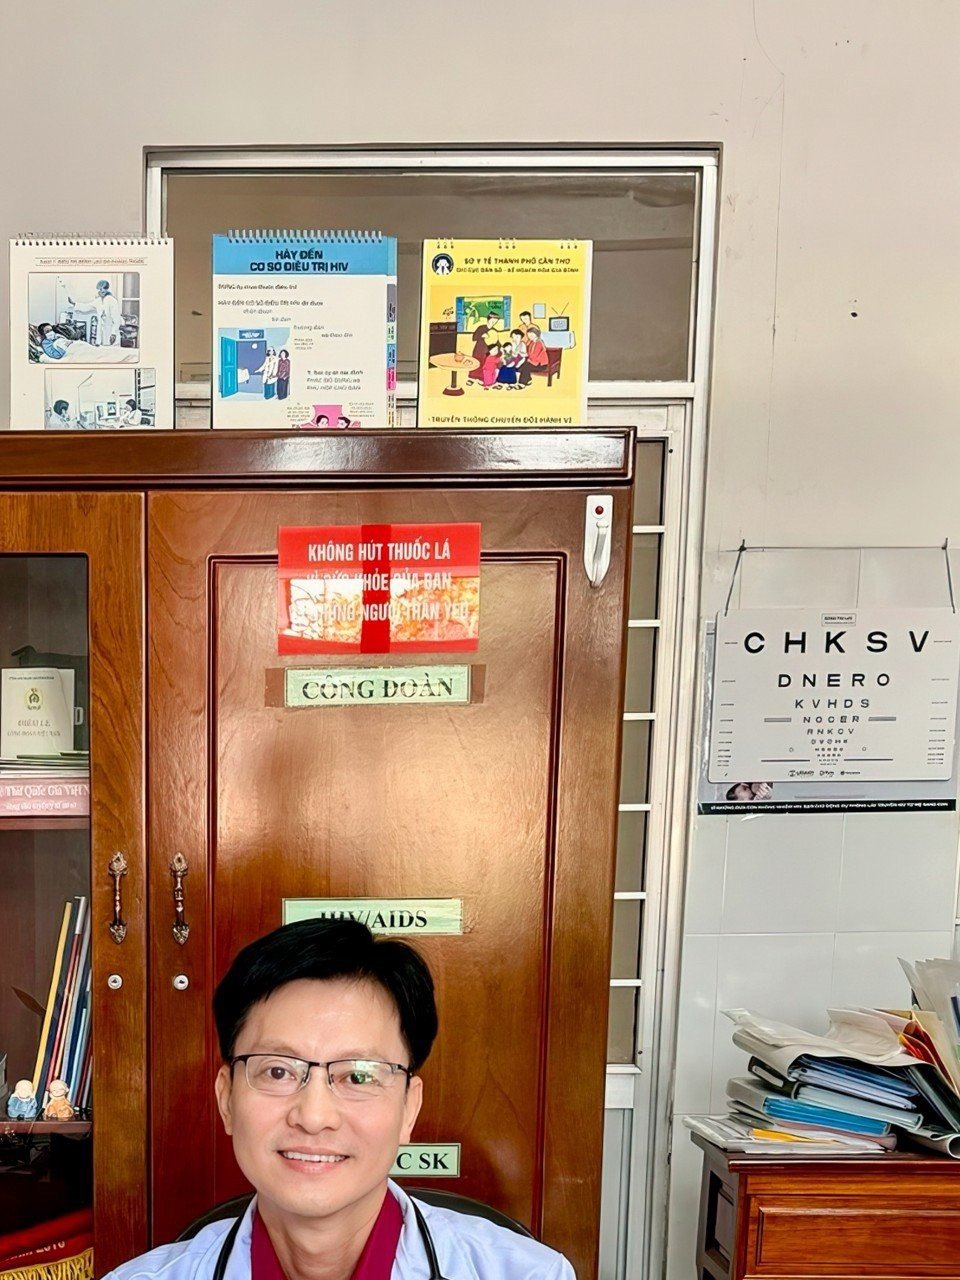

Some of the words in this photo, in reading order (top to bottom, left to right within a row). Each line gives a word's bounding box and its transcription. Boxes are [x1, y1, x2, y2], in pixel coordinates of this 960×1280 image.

[330, 262, 349, 272] HIV
[308, 540, 354, 562] KHÔNG
[358, 539, 384, 561] HÚT
[387, 536, 430, 560] THUỐC
[434, 538, 451, 560] LÁ
[743, 631, 766, 654] C
[784, 631, 807, 653] H
[825, 631, 847, 653] K
[866, 631, 888, 653] S
[908, 630, 930, 653] V
[302, 674, 375, 700] CÔNG
[382, 672, 454, 698] ĐOÀN
[418, 1152, 449, 1170] SK
